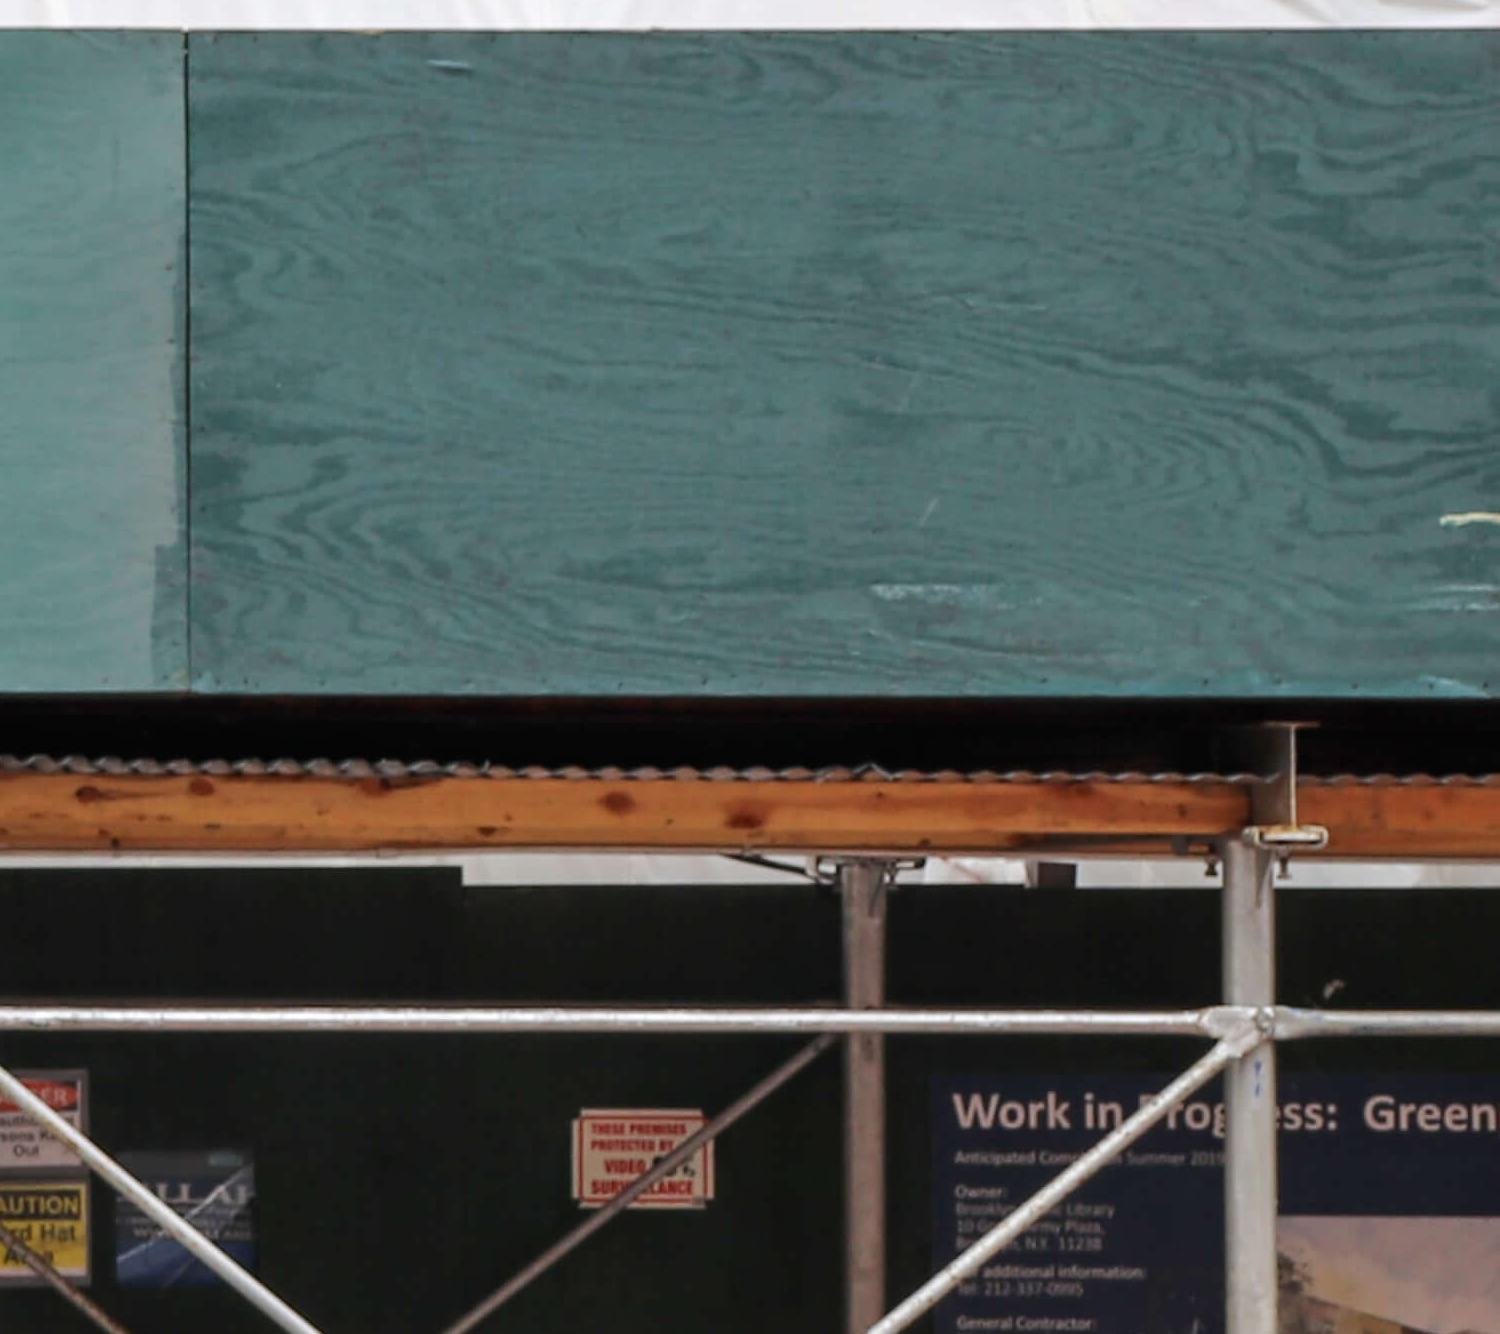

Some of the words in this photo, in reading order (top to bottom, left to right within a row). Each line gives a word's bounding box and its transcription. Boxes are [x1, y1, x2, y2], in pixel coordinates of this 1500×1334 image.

[952, 1091, 1072, 1129] Work
[1085, 1091, 1124, 1129] in
[1363, 1093, 1498, 1132] Green
[954, 1151, 1036, 1166] Anticipated
[605, 1159, 646, 1174] VIDEO
[954, 1184, 1006, 1199] Owner:
[982, 1264, 1056, 1279] additional
[1058, 1264, 1147, 1279] information:
[956, 1317, 1013, 1332] General
[1015, 1317, 1097, 1332] Contractor:
